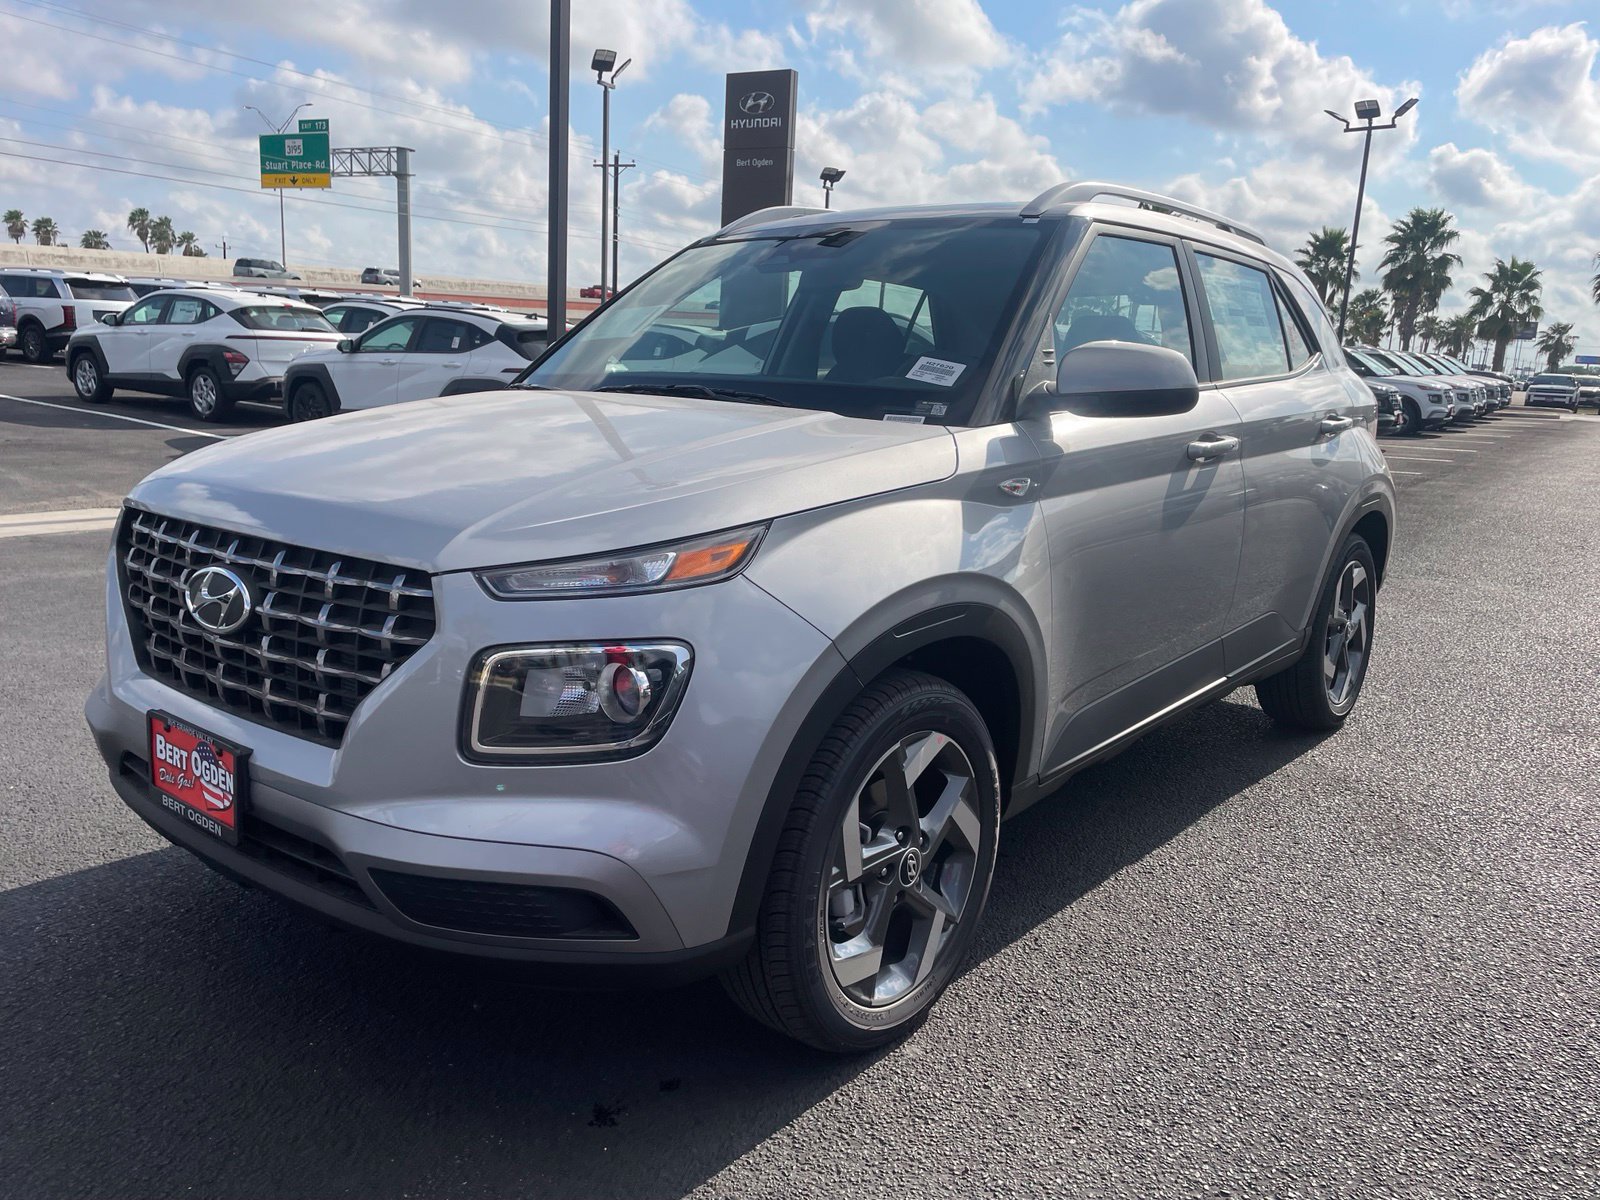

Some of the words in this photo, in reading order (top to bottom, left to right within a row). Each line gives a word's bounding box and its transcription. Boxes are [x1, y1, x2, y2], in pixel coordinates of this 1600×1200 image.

[315, 121, 326, 130] 173
[730, 117, 782, 129] HYUNDAI
[286, 144, 302, 154] 3195
[265, 161, 288, 170] Stuart
[291, 160, 312, 169] Place
[315, 160, 326, 169] Rd
[736, 158, 750, 167] Bert
[752, 158, 773, 168] Ogden
[155, 733, 188, 771] BERT
[191, 750, 234, 795] OGDEN
[162, 794, 186, 816] BERT
[187, 810, 222, 837] OGDEN
